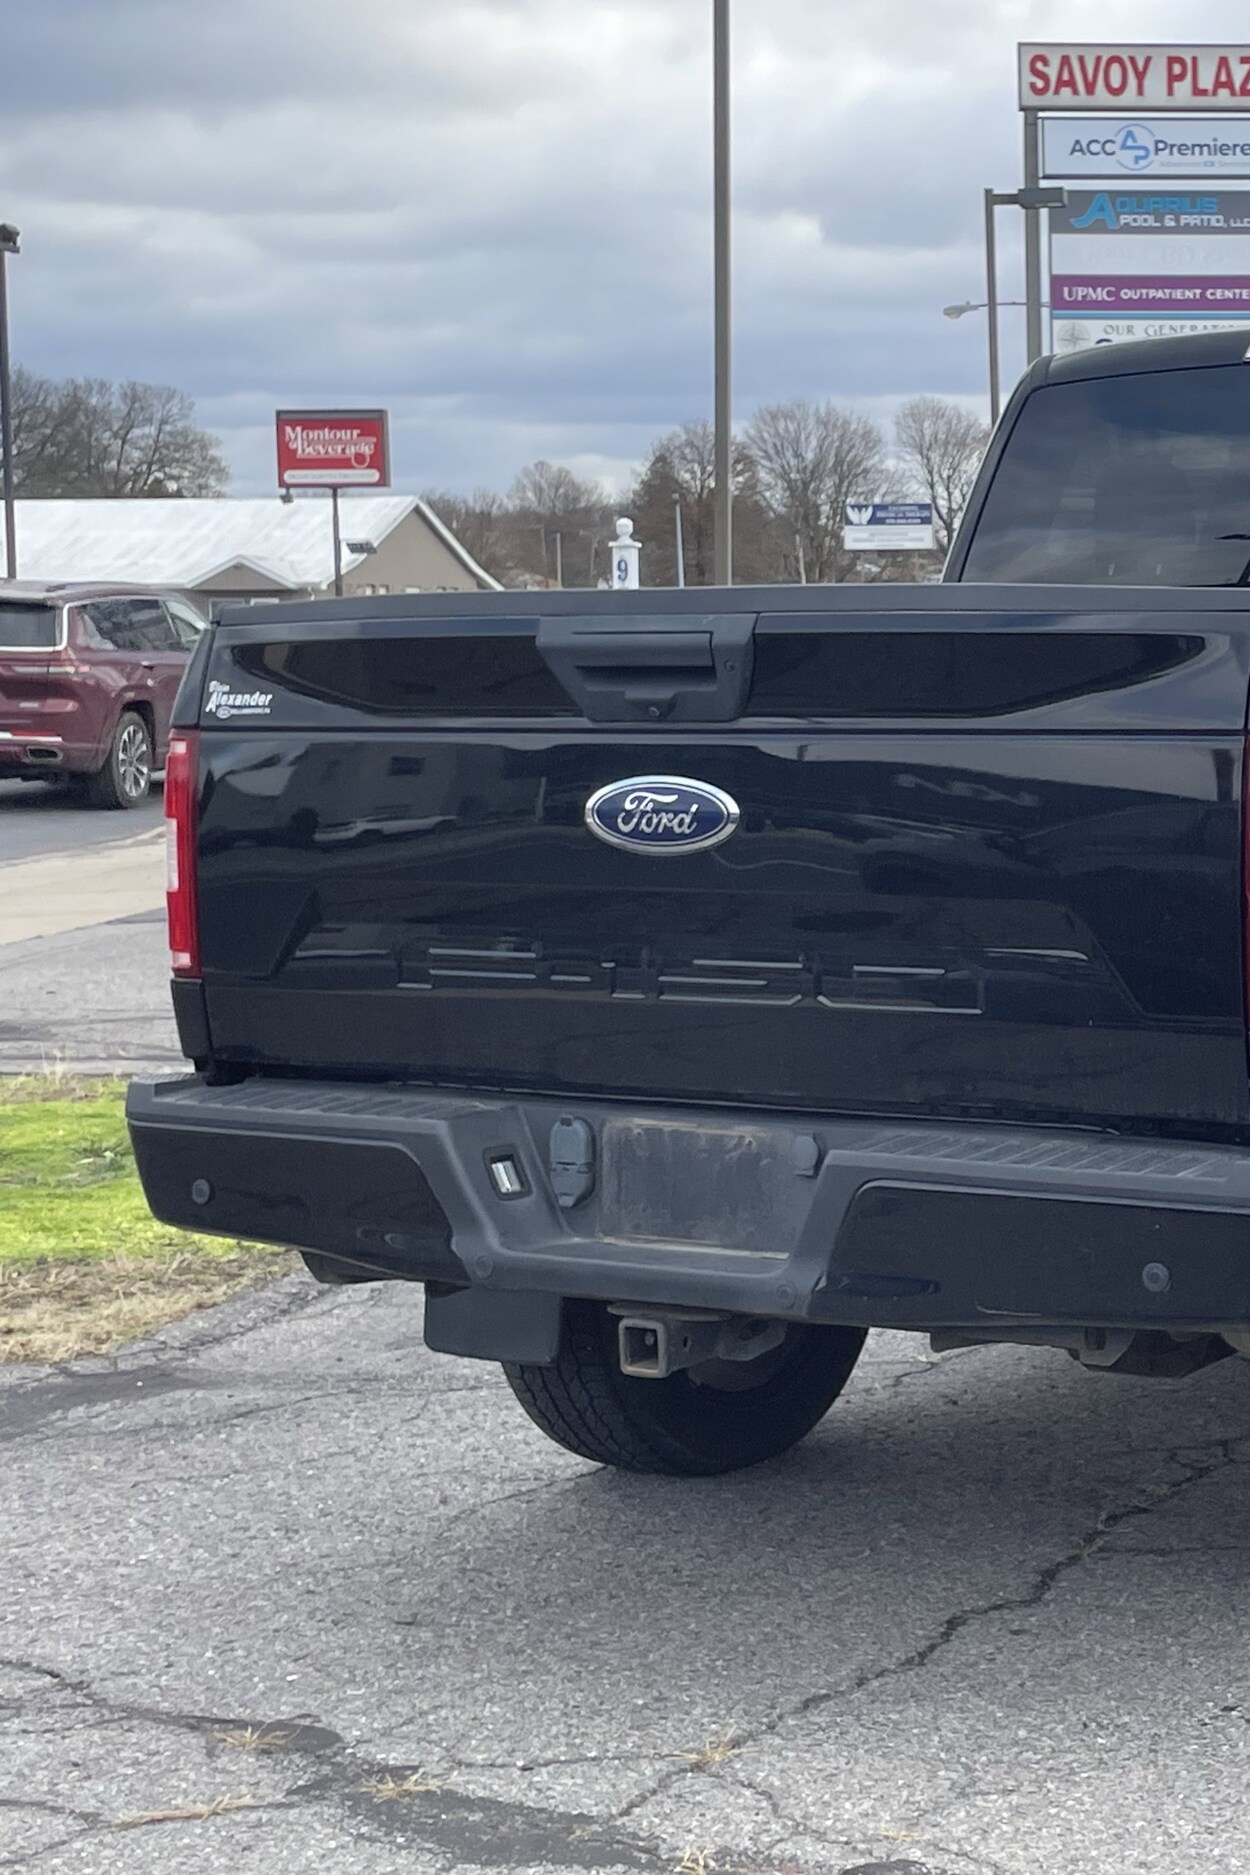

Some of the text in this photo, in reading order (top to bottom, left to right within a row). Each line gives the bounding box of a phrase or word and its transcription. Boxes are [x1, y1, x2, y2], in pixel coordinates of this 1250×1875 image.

[1028, 54, 1152, 97] SAVOY
[1069, 138, 1116, 157] ACC
[1070, 192, 1218, 229] AQUARIUS
[1119, 214, 1161, 227] POOL
[1164, 214, 1177, 227] &
[1063, 286, 1116, 301] UPMC
[1120, 288, 1202, 300] OUTPATIENT
[1103, 324, 1136, 336] OUR
[284, 425, 361, 450] Montour
[617, 559, 628, 582] 9
[205, 690, 273, 713] Alexander
[617, 791, 699, 834] Ford
